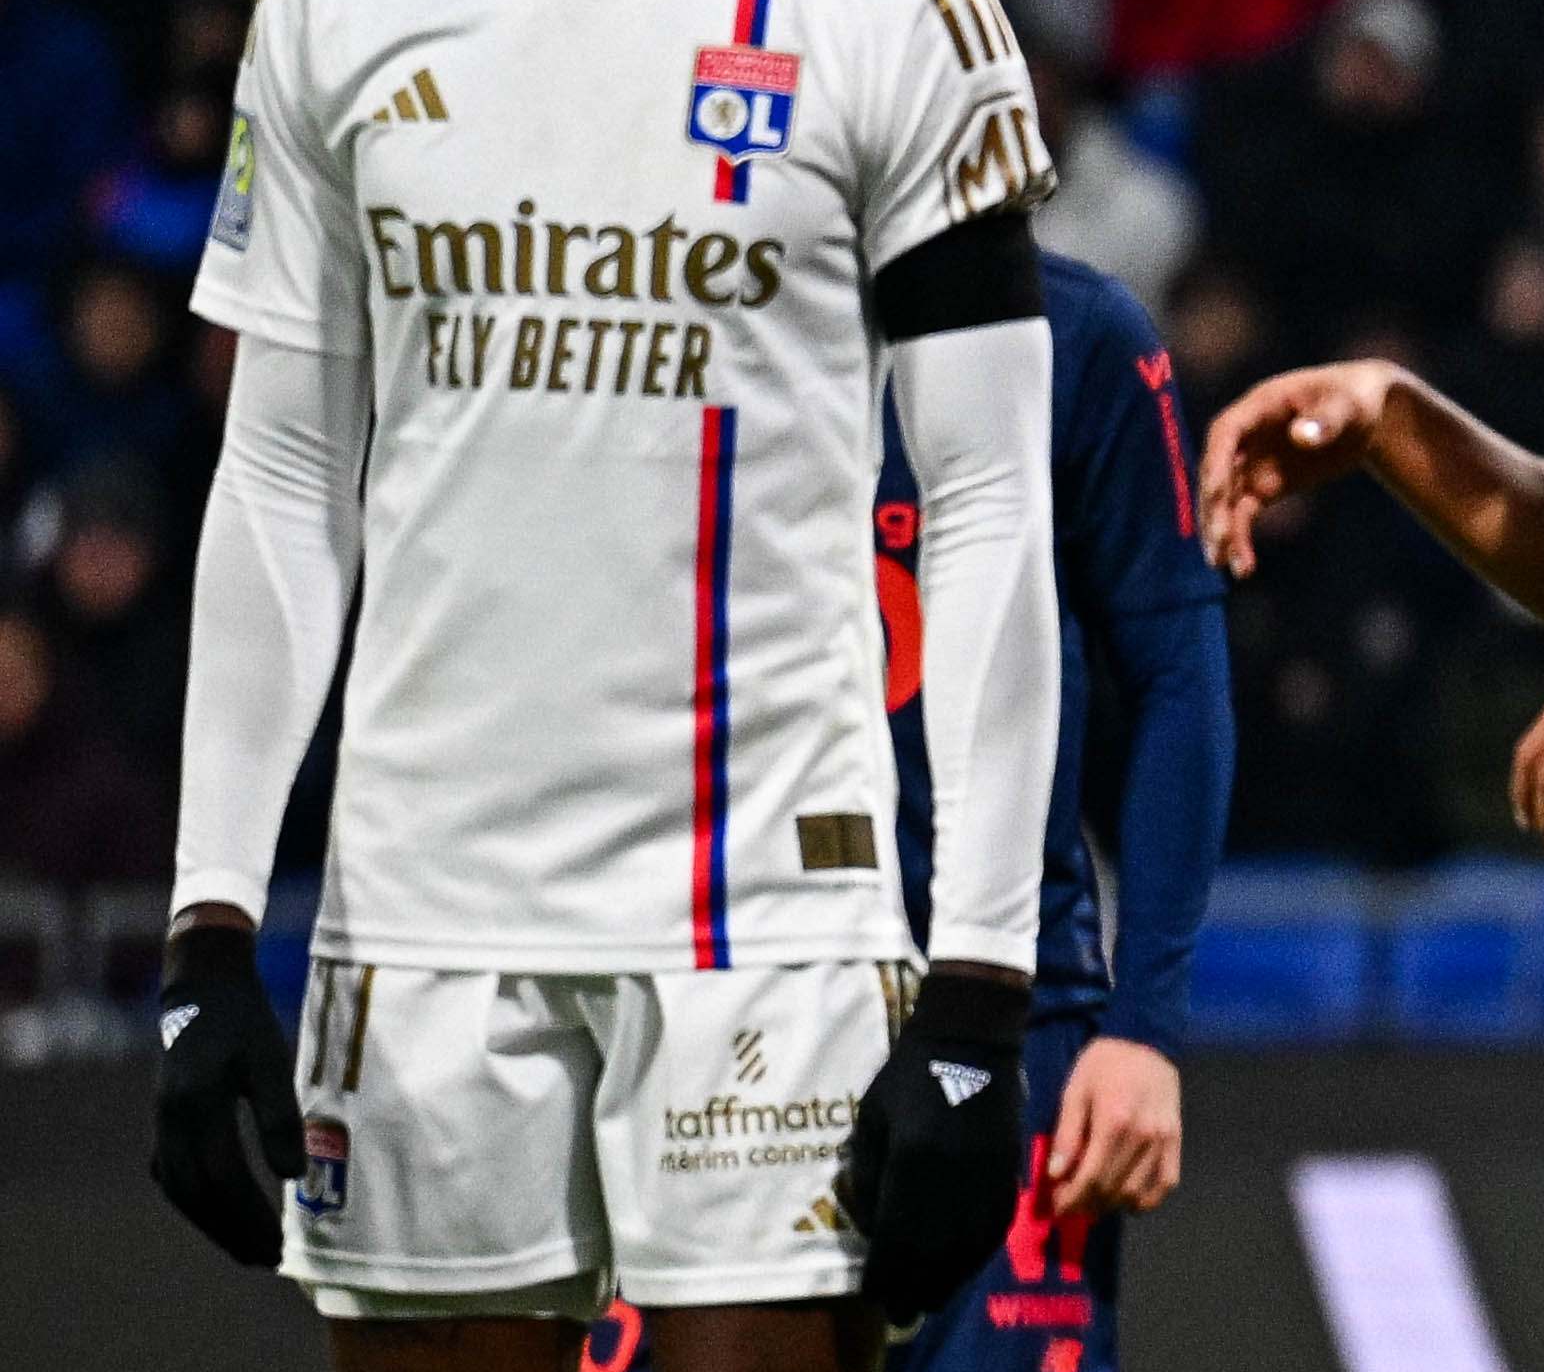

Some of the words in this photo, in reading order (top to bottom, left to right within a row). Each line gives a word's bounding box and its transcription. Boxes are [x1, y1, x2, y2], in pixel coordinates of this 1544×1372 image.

[696, 88, 783, 148] OL
[366, 198, 787, 309] Emirates
[426, 313, 496, 391] FLY
[508, 315, 715, 400] BETTER
